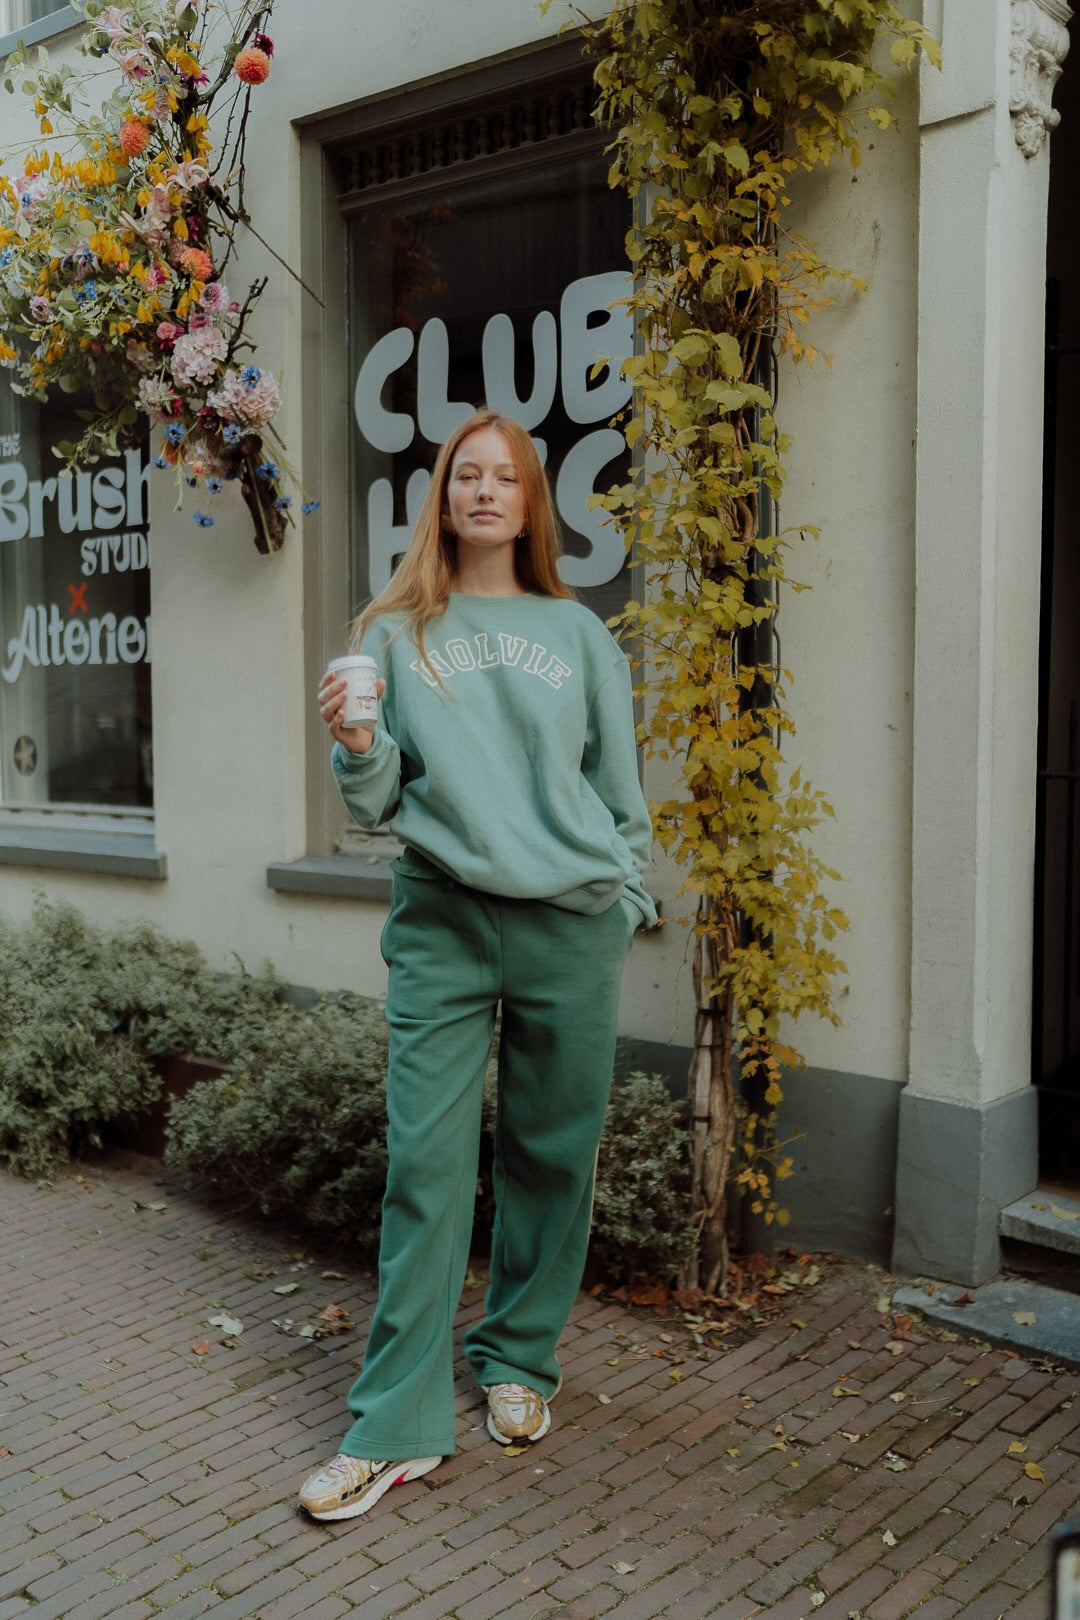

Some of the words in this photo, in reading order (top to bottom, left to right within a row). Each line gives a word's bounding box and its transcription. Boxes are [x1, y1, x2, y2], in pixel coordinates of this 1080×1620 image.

[355, 270, 634, 453] CLUB
[0, 449, 151, 542] Brush
[368, 428, 628, 600] HS
